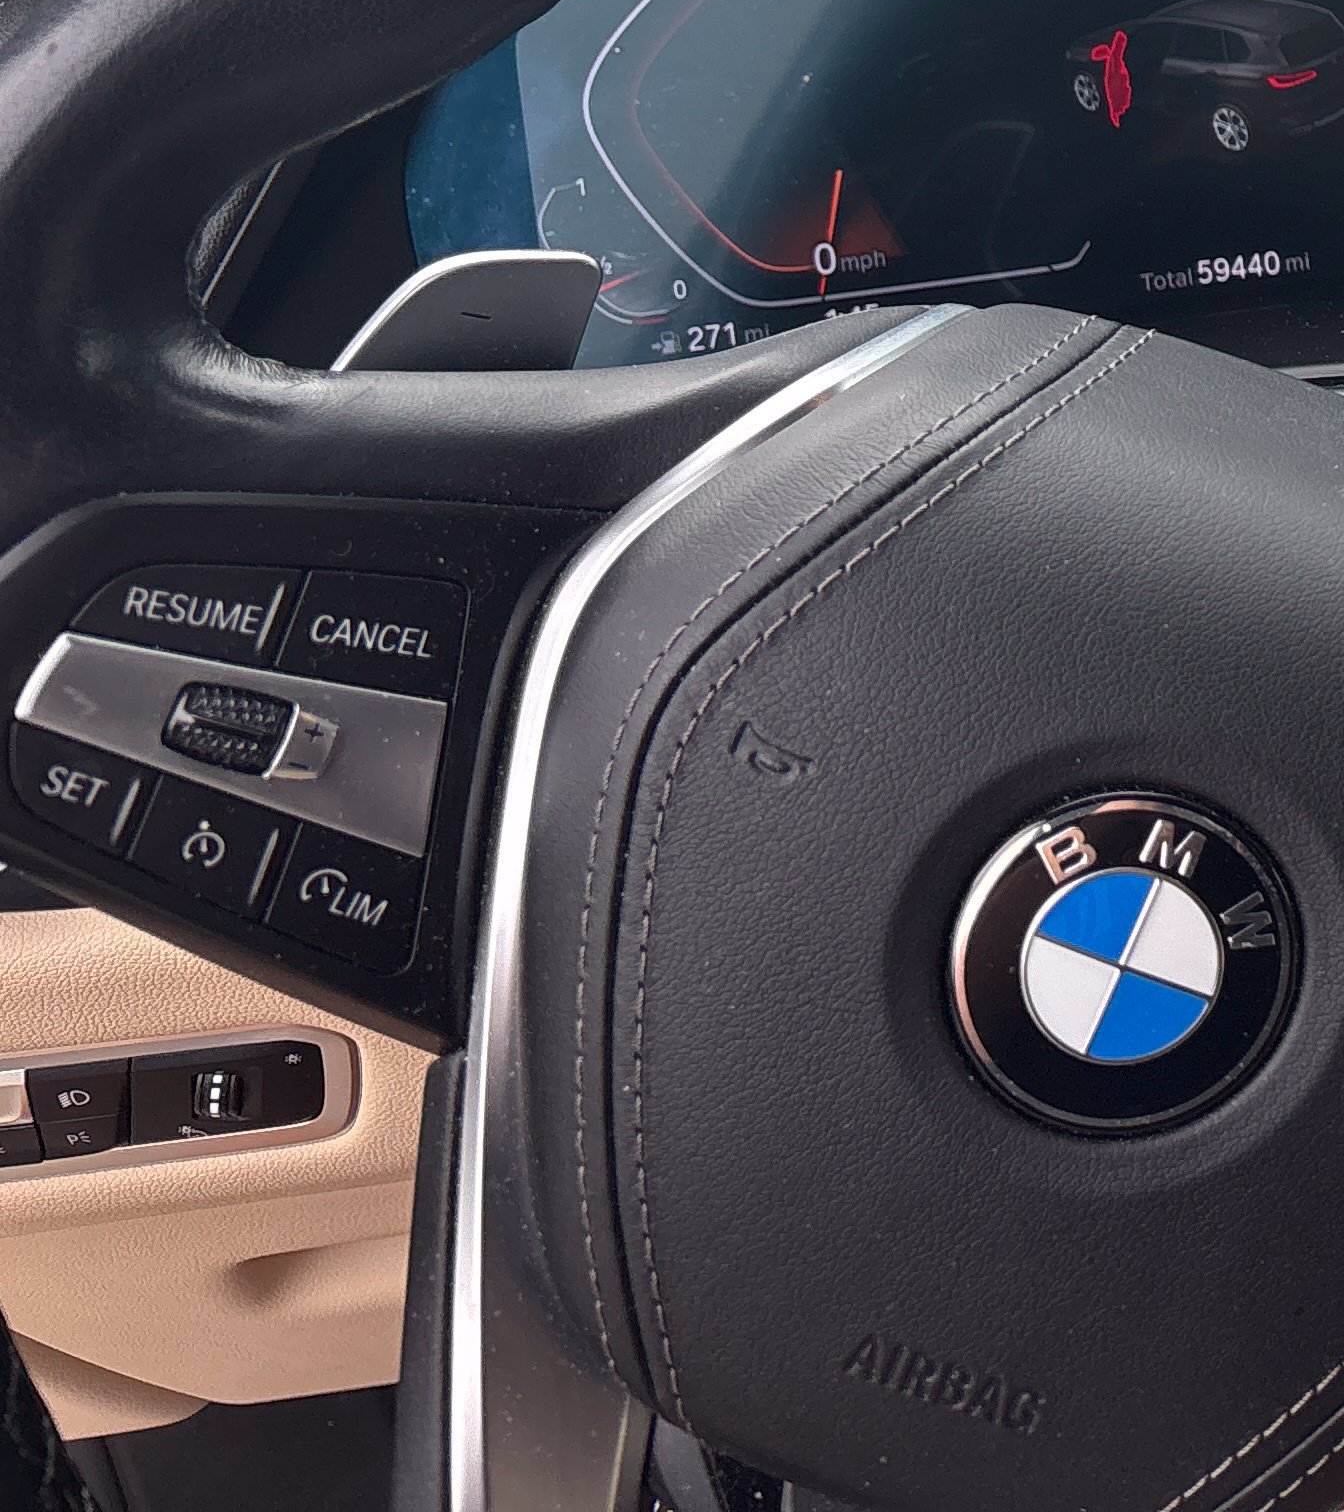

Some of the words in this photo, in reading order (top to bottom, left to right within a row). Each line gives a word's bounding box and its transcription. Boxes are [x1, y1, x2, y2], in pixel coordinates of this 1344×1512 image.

[814, 242, 838, 277] 0
[840, 248, 887, 274] mph
[1140, 268, 1195, 292] Total
[1196, 251, 1281, 285] 59440
[1285, 252, 1312, 274] mi
[672, 279, 687, 300] 0
[687, 324, 738, 353] 271
[122, 585, 264, 635] RESUME
[310, 614, 433, 660] CANCEL
[40, 765, 109, 809] SET
[1035, 819, 1276, 951] BMW
[329, 891, 389, 928] LIM
[841, 1331, 1050, 1436] AIRBAG
